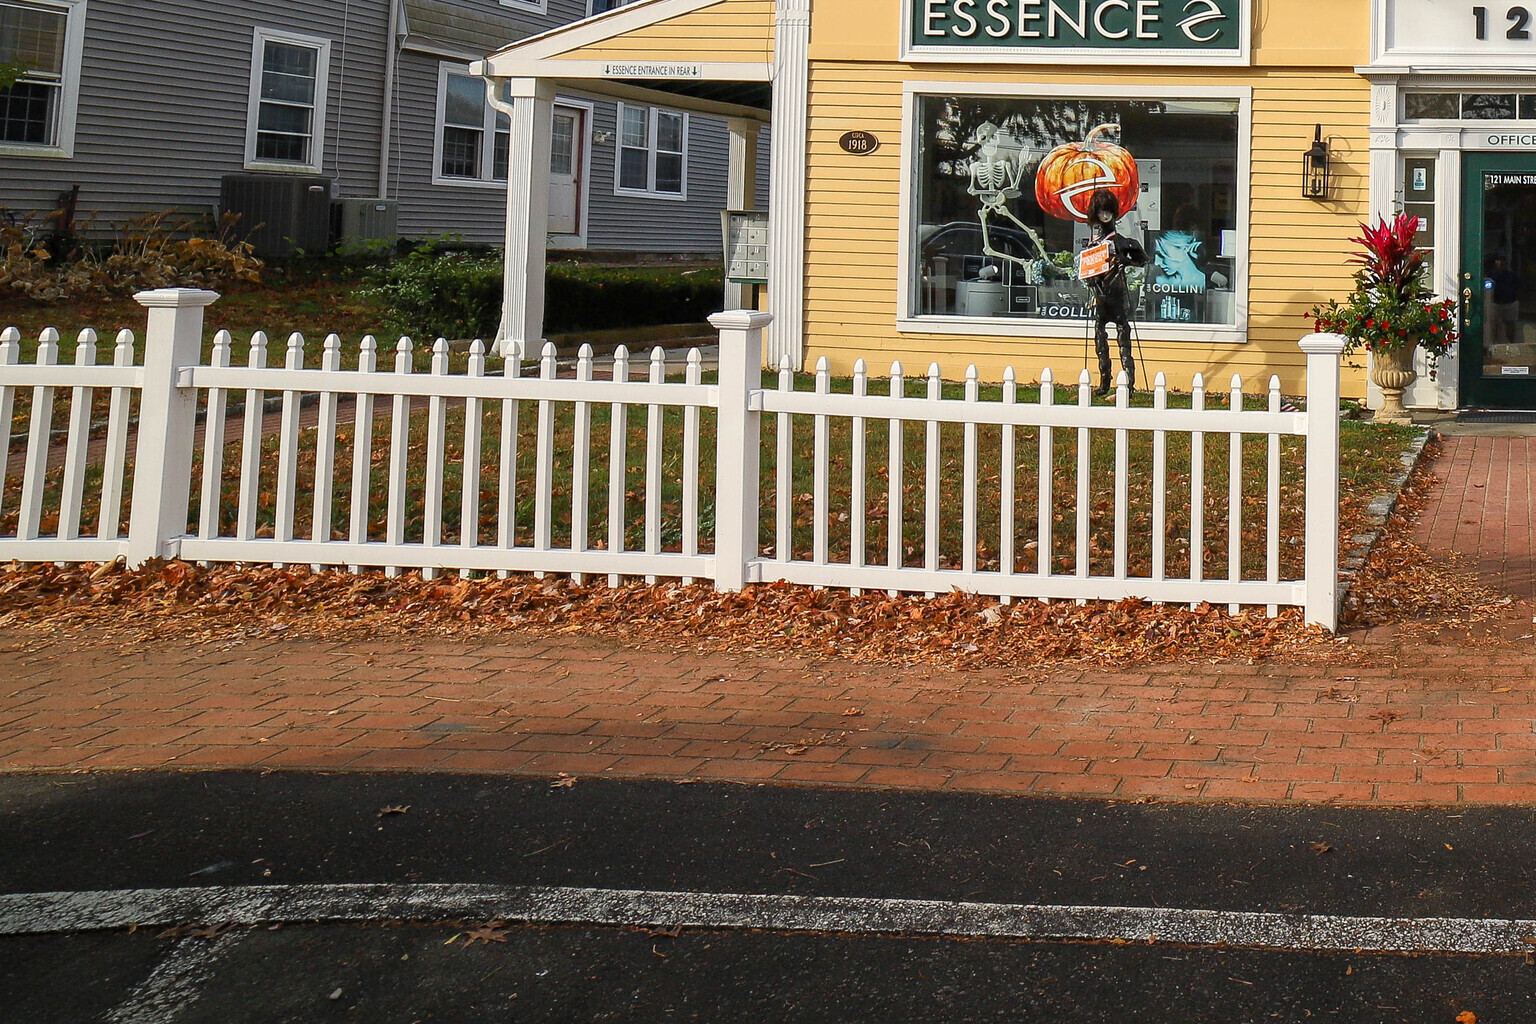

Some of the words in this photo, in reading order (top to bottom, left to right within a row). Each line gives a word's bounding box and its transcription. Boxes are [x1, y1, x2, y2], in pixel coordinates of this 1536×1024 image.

[612, 65, 636, 75] ESSENCE
[638, 65, 667, 75] ENTRANCE
[669, 66, 675, 75] IN
[677, 66, 690, 76] REAR
[848, 139, 867, 150] 1918
[1490, 175, 1502, 184] 121
[1503, 175, 1522, 185] MAIN
[1152, 283, 1198, 294] COLLIN
